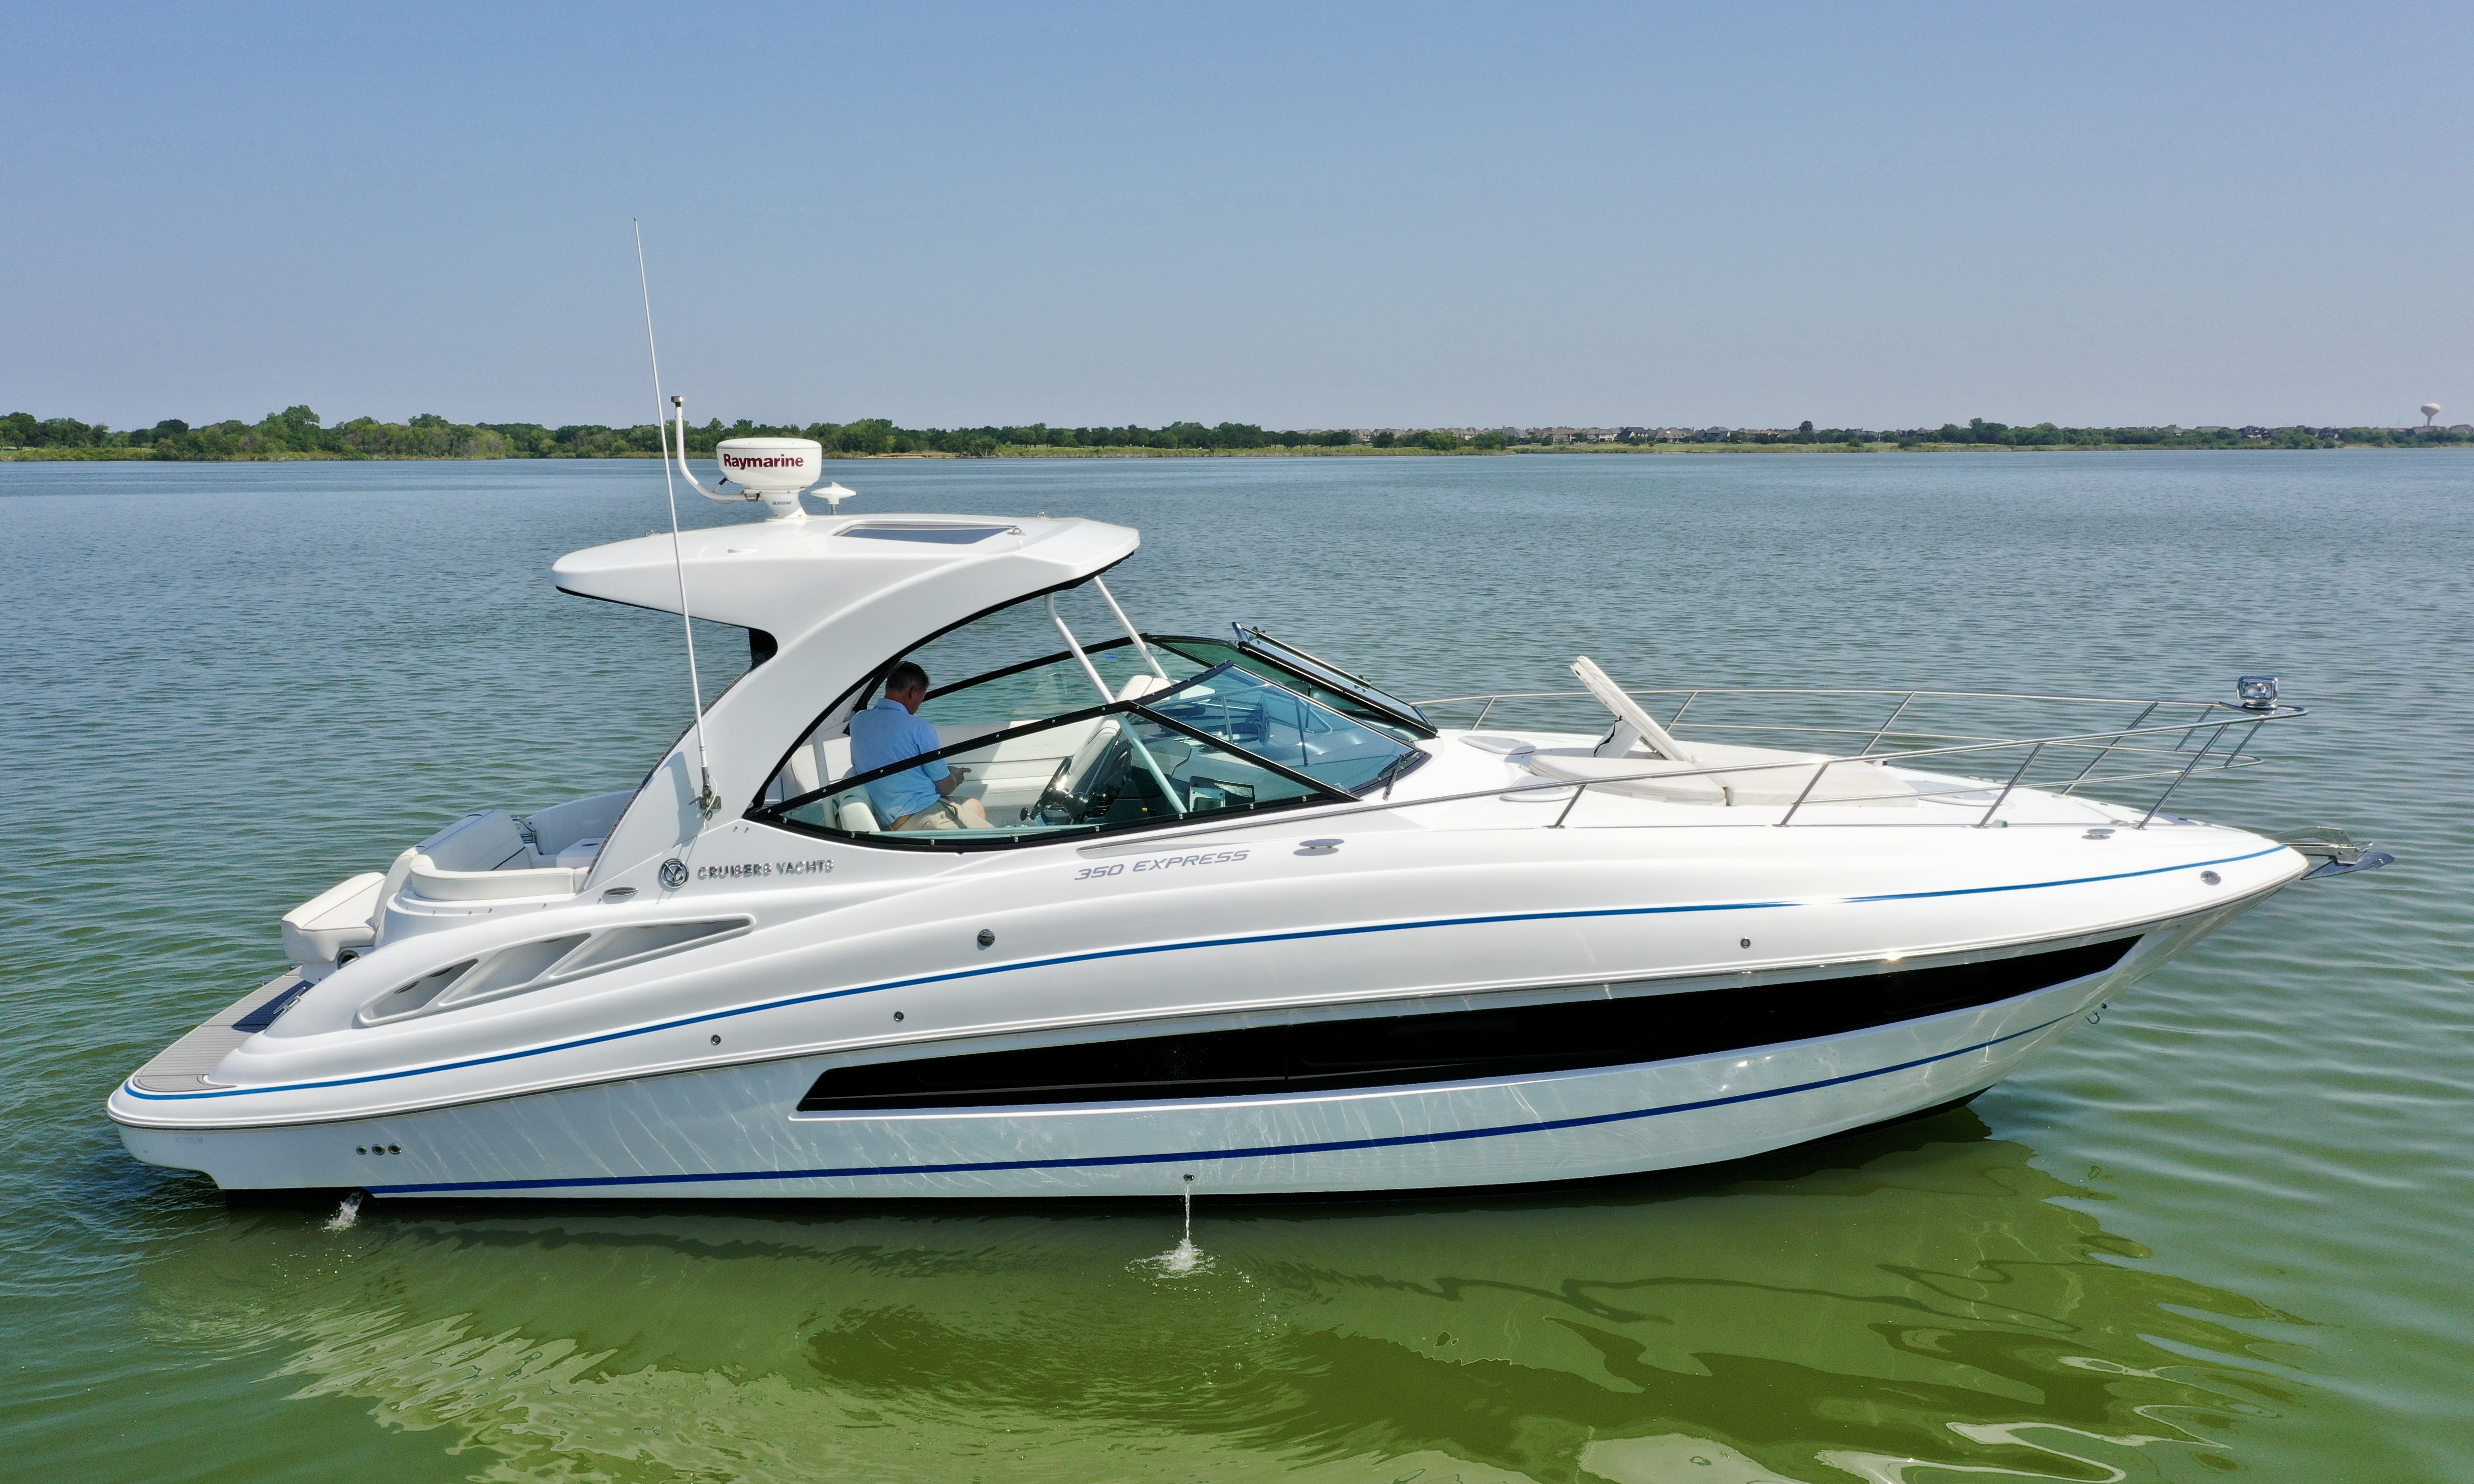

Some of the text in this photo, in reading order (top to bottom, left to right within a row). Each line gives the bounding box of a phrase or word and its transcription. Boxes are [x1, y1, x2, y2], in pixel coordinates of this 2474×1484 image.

[724, 453, 804, 470] Raymarine
[698, 859, 835, 878] CRUISERS YACHTS
[1074, 850, 1251, 881] 350 EXPRESS
